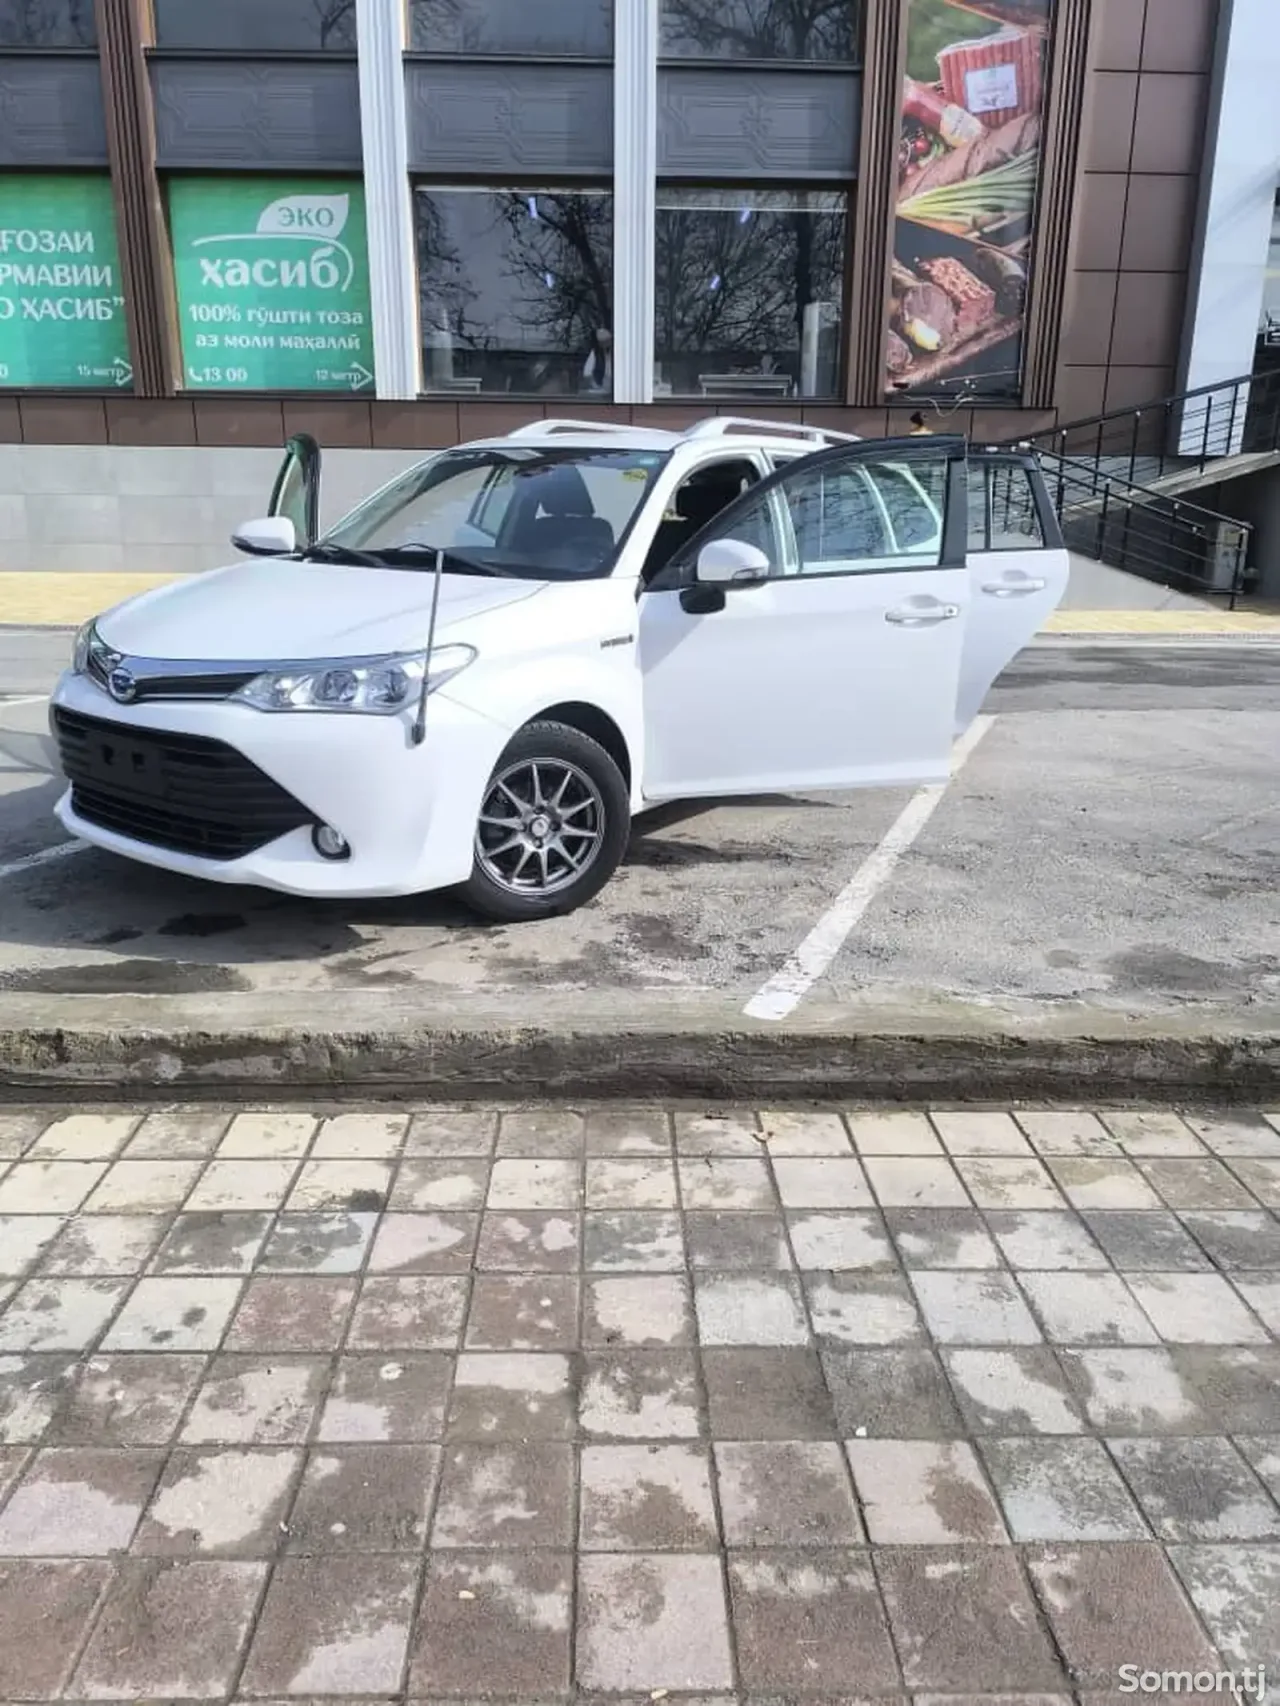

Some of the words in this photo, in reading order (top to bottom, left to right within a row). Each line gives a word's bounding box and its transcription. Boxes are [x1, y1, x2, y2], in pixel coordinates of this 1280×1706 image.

[278, 206, 334, 227] ЭКО
[0, 263, 112, 288] РМАВИИ
[189, 303, 242, 323] 100%
[318, 309, 364, 325] тоза
[195, 333, 219, 348] аз
[223, 334, 275, 348] моли
[203, 366, 222, 382] 13
[226, 366, 249, 382] 00
